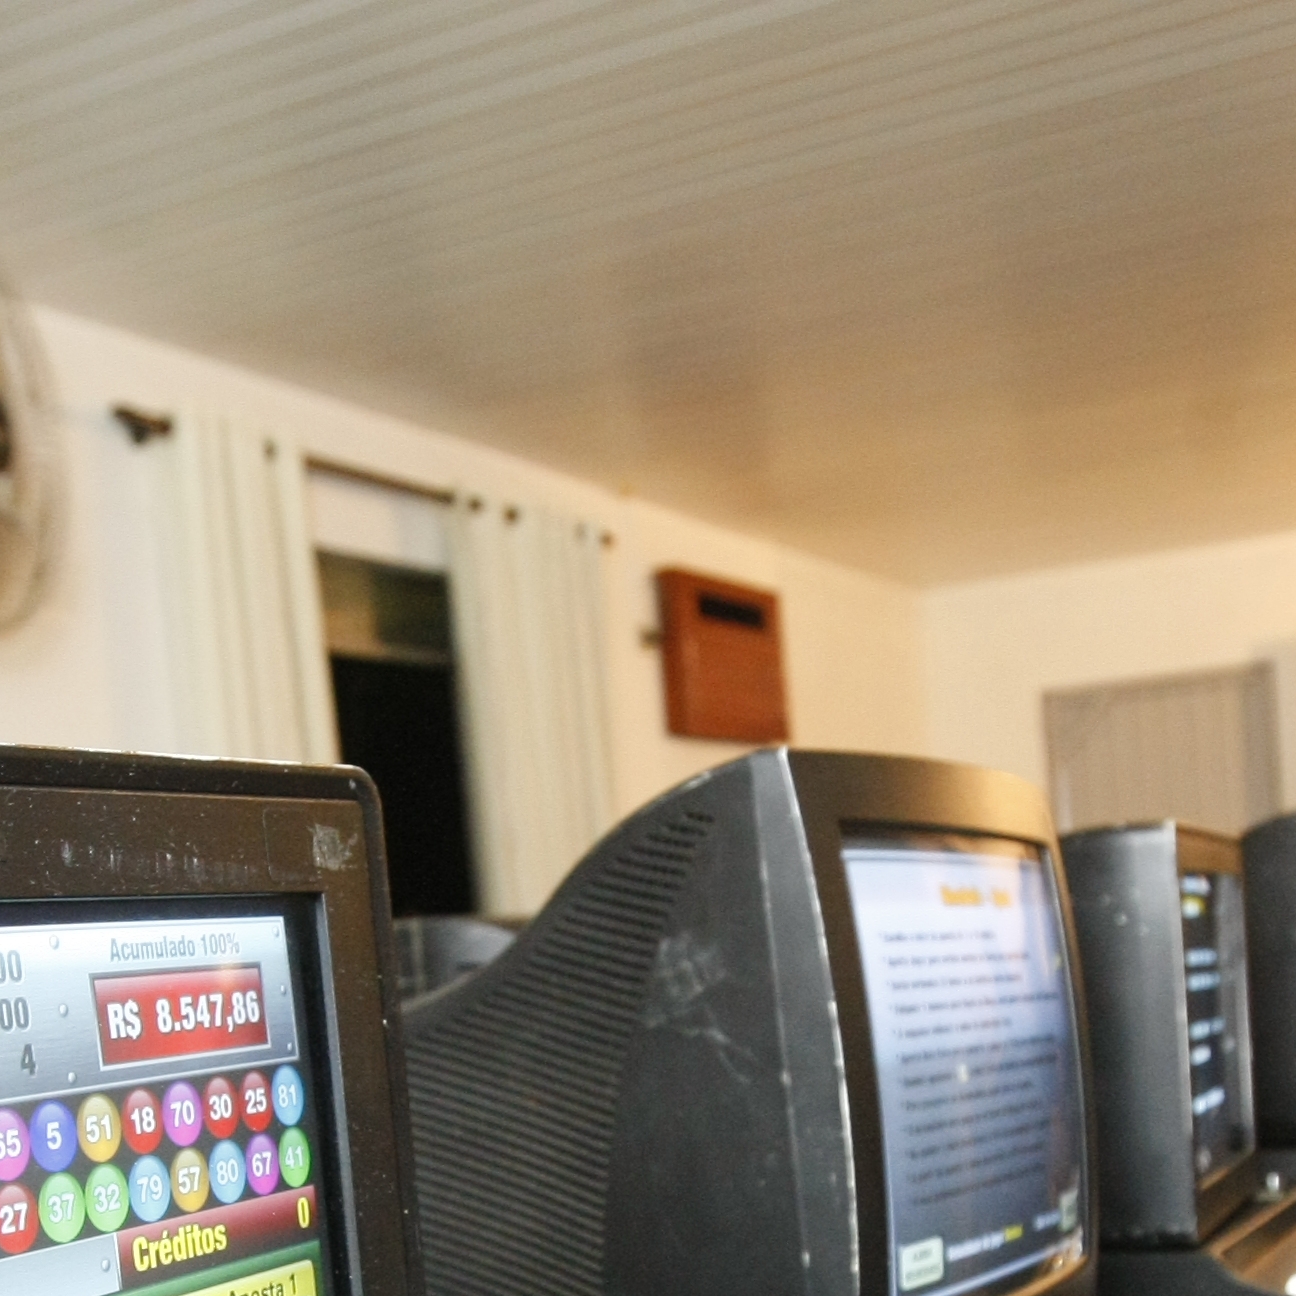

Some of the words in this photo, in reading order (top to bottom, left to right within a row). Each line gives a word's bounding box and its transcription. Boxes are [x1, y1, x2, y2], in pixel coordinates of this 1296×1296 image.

[110, 936, 196, 962] Acumulado
[201, 933, 240, 956] 100%
[107, 1000, 142, 1039] R$
[156, 991, 260, 1032] 8.547,86
[21, 1043, 36, 1076] 4
[47, 1122, 61, 1150] 5
[85, 1114, 112, 1143] 51
[131, 1106, 155, 1134] 18
[170, 1100, 194, 1127] 70
[209, 1094, 232, 1120] 30
[245, 1089, 267, 1114] 25
[278, 1087, 296, 1108] 81
[0, 1202, 27, 1234] 27
[48, 1193, 74, 1223] 37
[94, 1183, 121, 1213] 32
[137, 1175, 162, 1204] 79
[178, 1166, 200, 1194] 57
[216, 1159, 238, 1185] 80
[252, 1152, 271, 1177] 67
[285, 1147, 303, 1168] 41
[132, 1223, 227, 1271] Créditos
[297, 1196, 310, 1229] 0
[289, 1273, 296, 1295] 1
